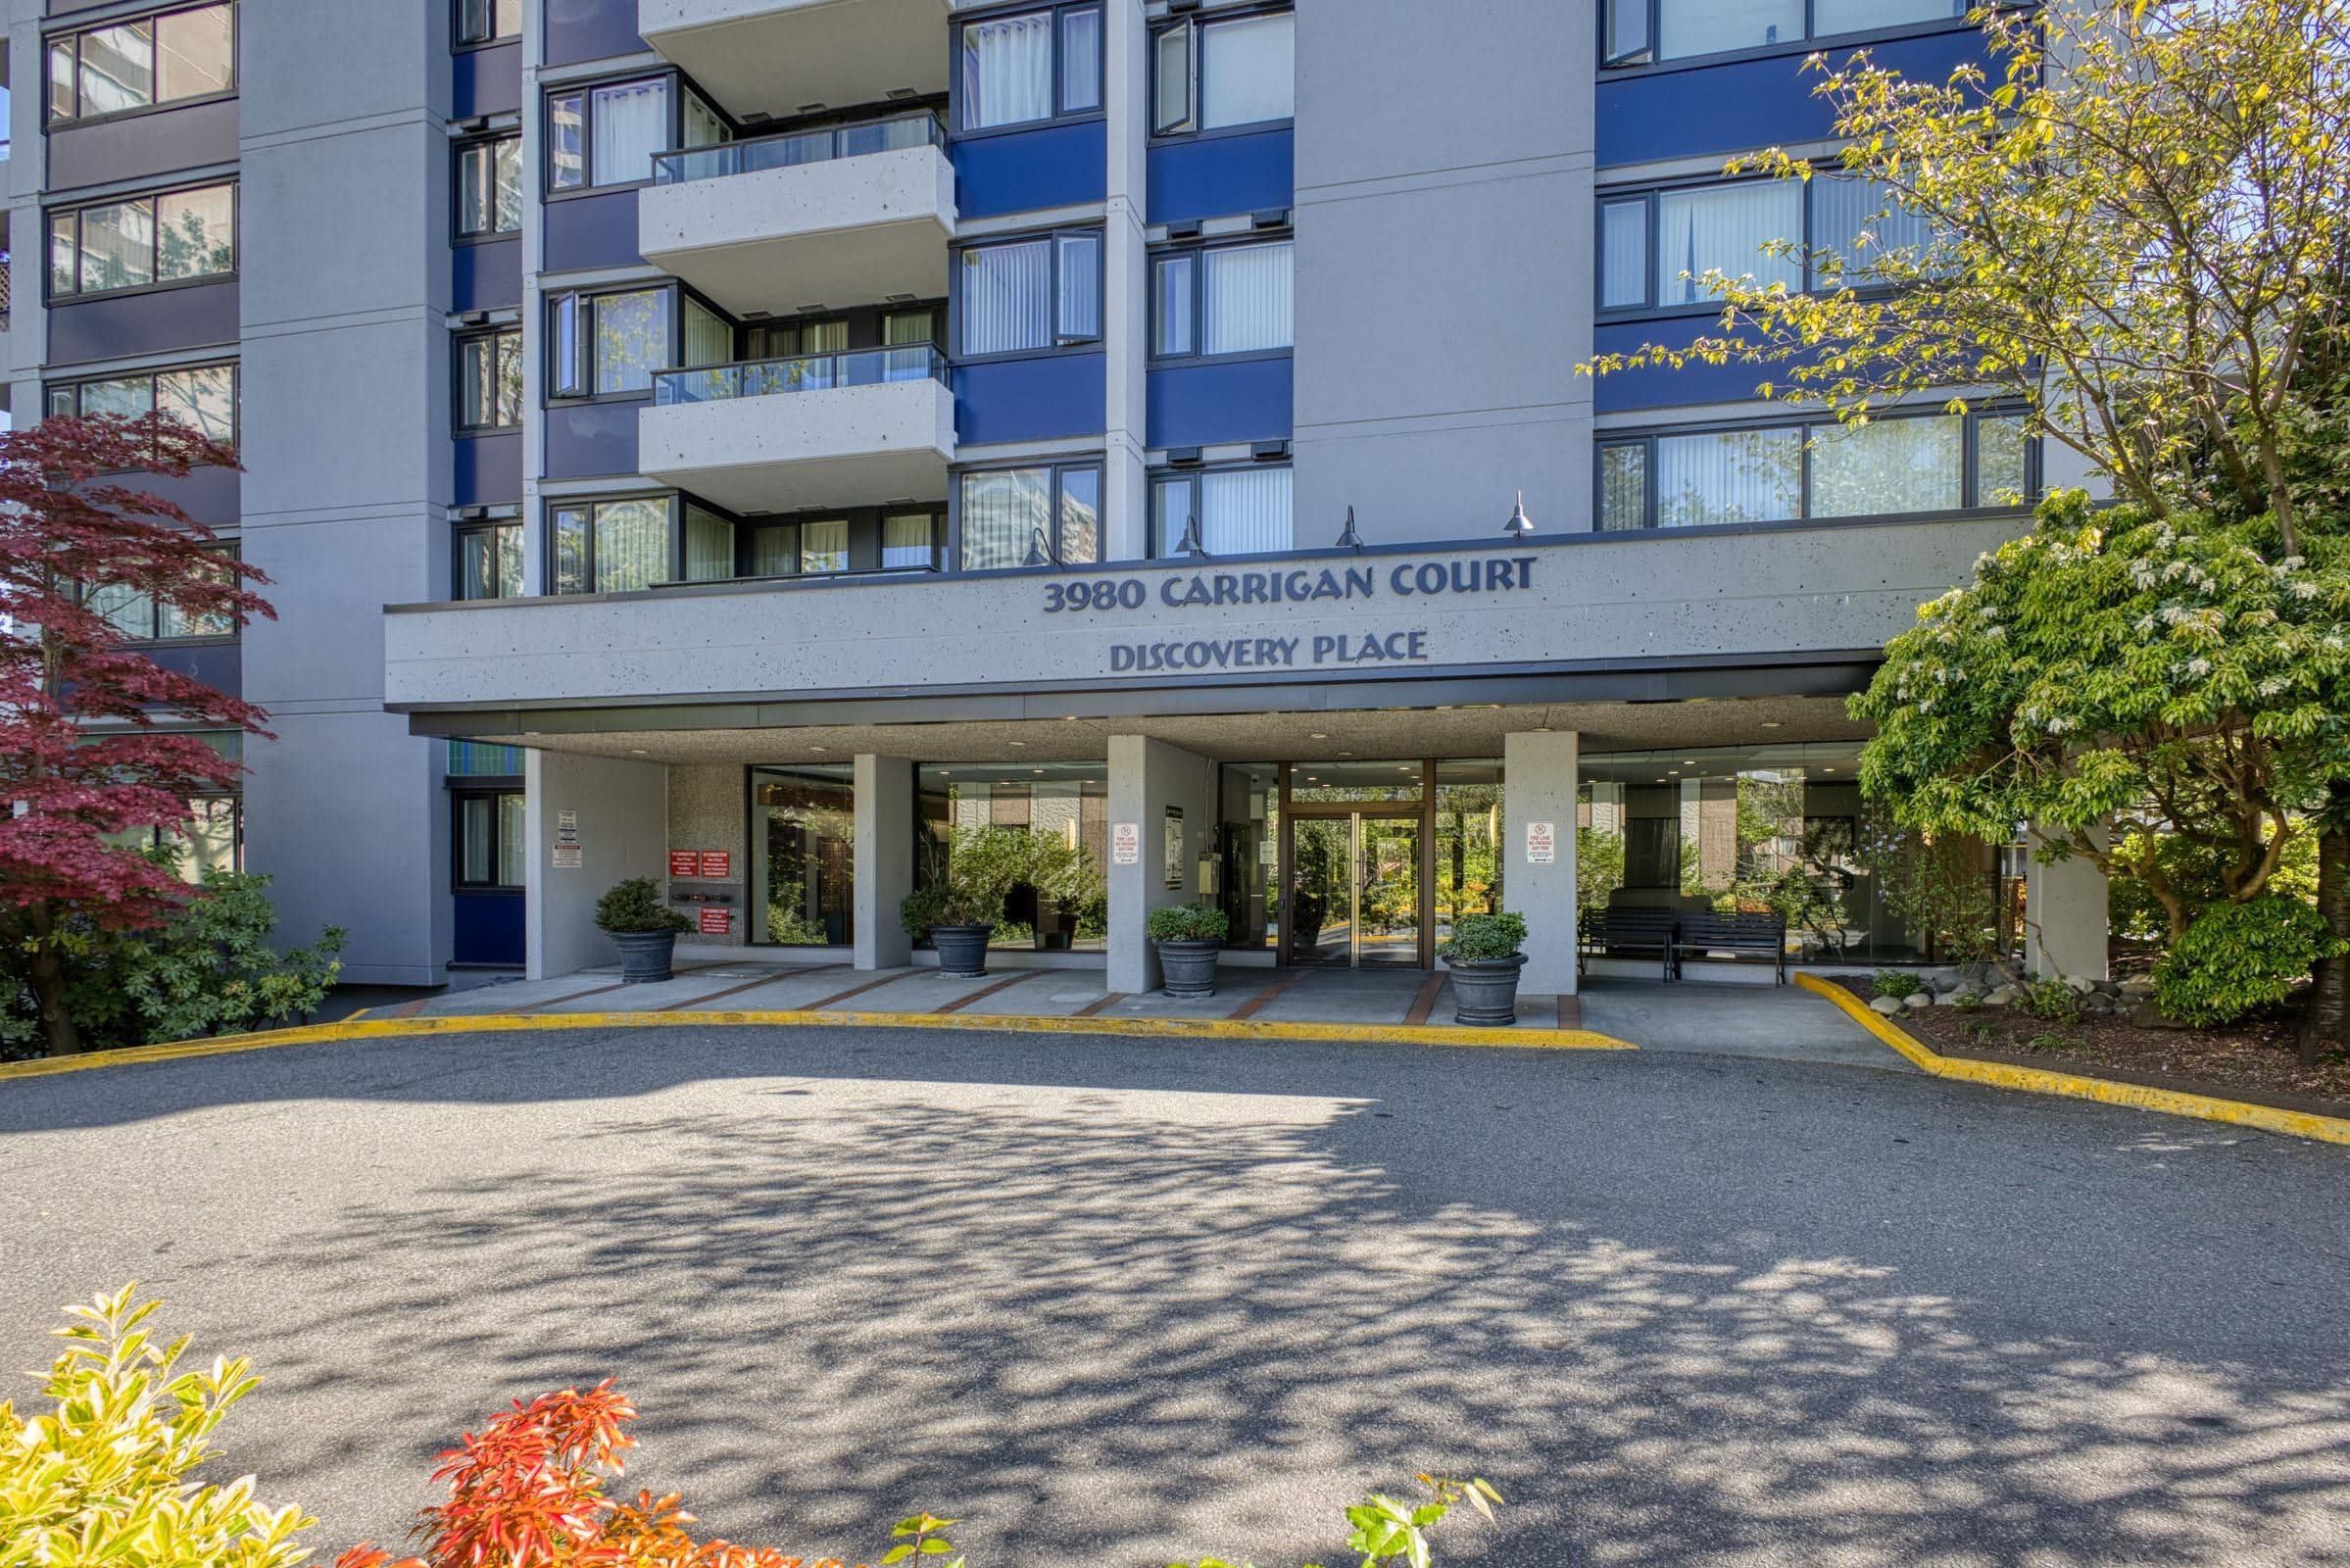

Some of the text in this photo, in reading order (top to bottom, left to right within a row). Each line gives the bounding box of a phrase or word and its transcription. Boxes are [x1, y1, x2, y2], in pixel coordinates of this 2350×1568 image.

[1044, 557, 1538, 612] 3980 CARRIGAN COURT
[1110, 630, 1428, 671] DISCOVERY PLACE
